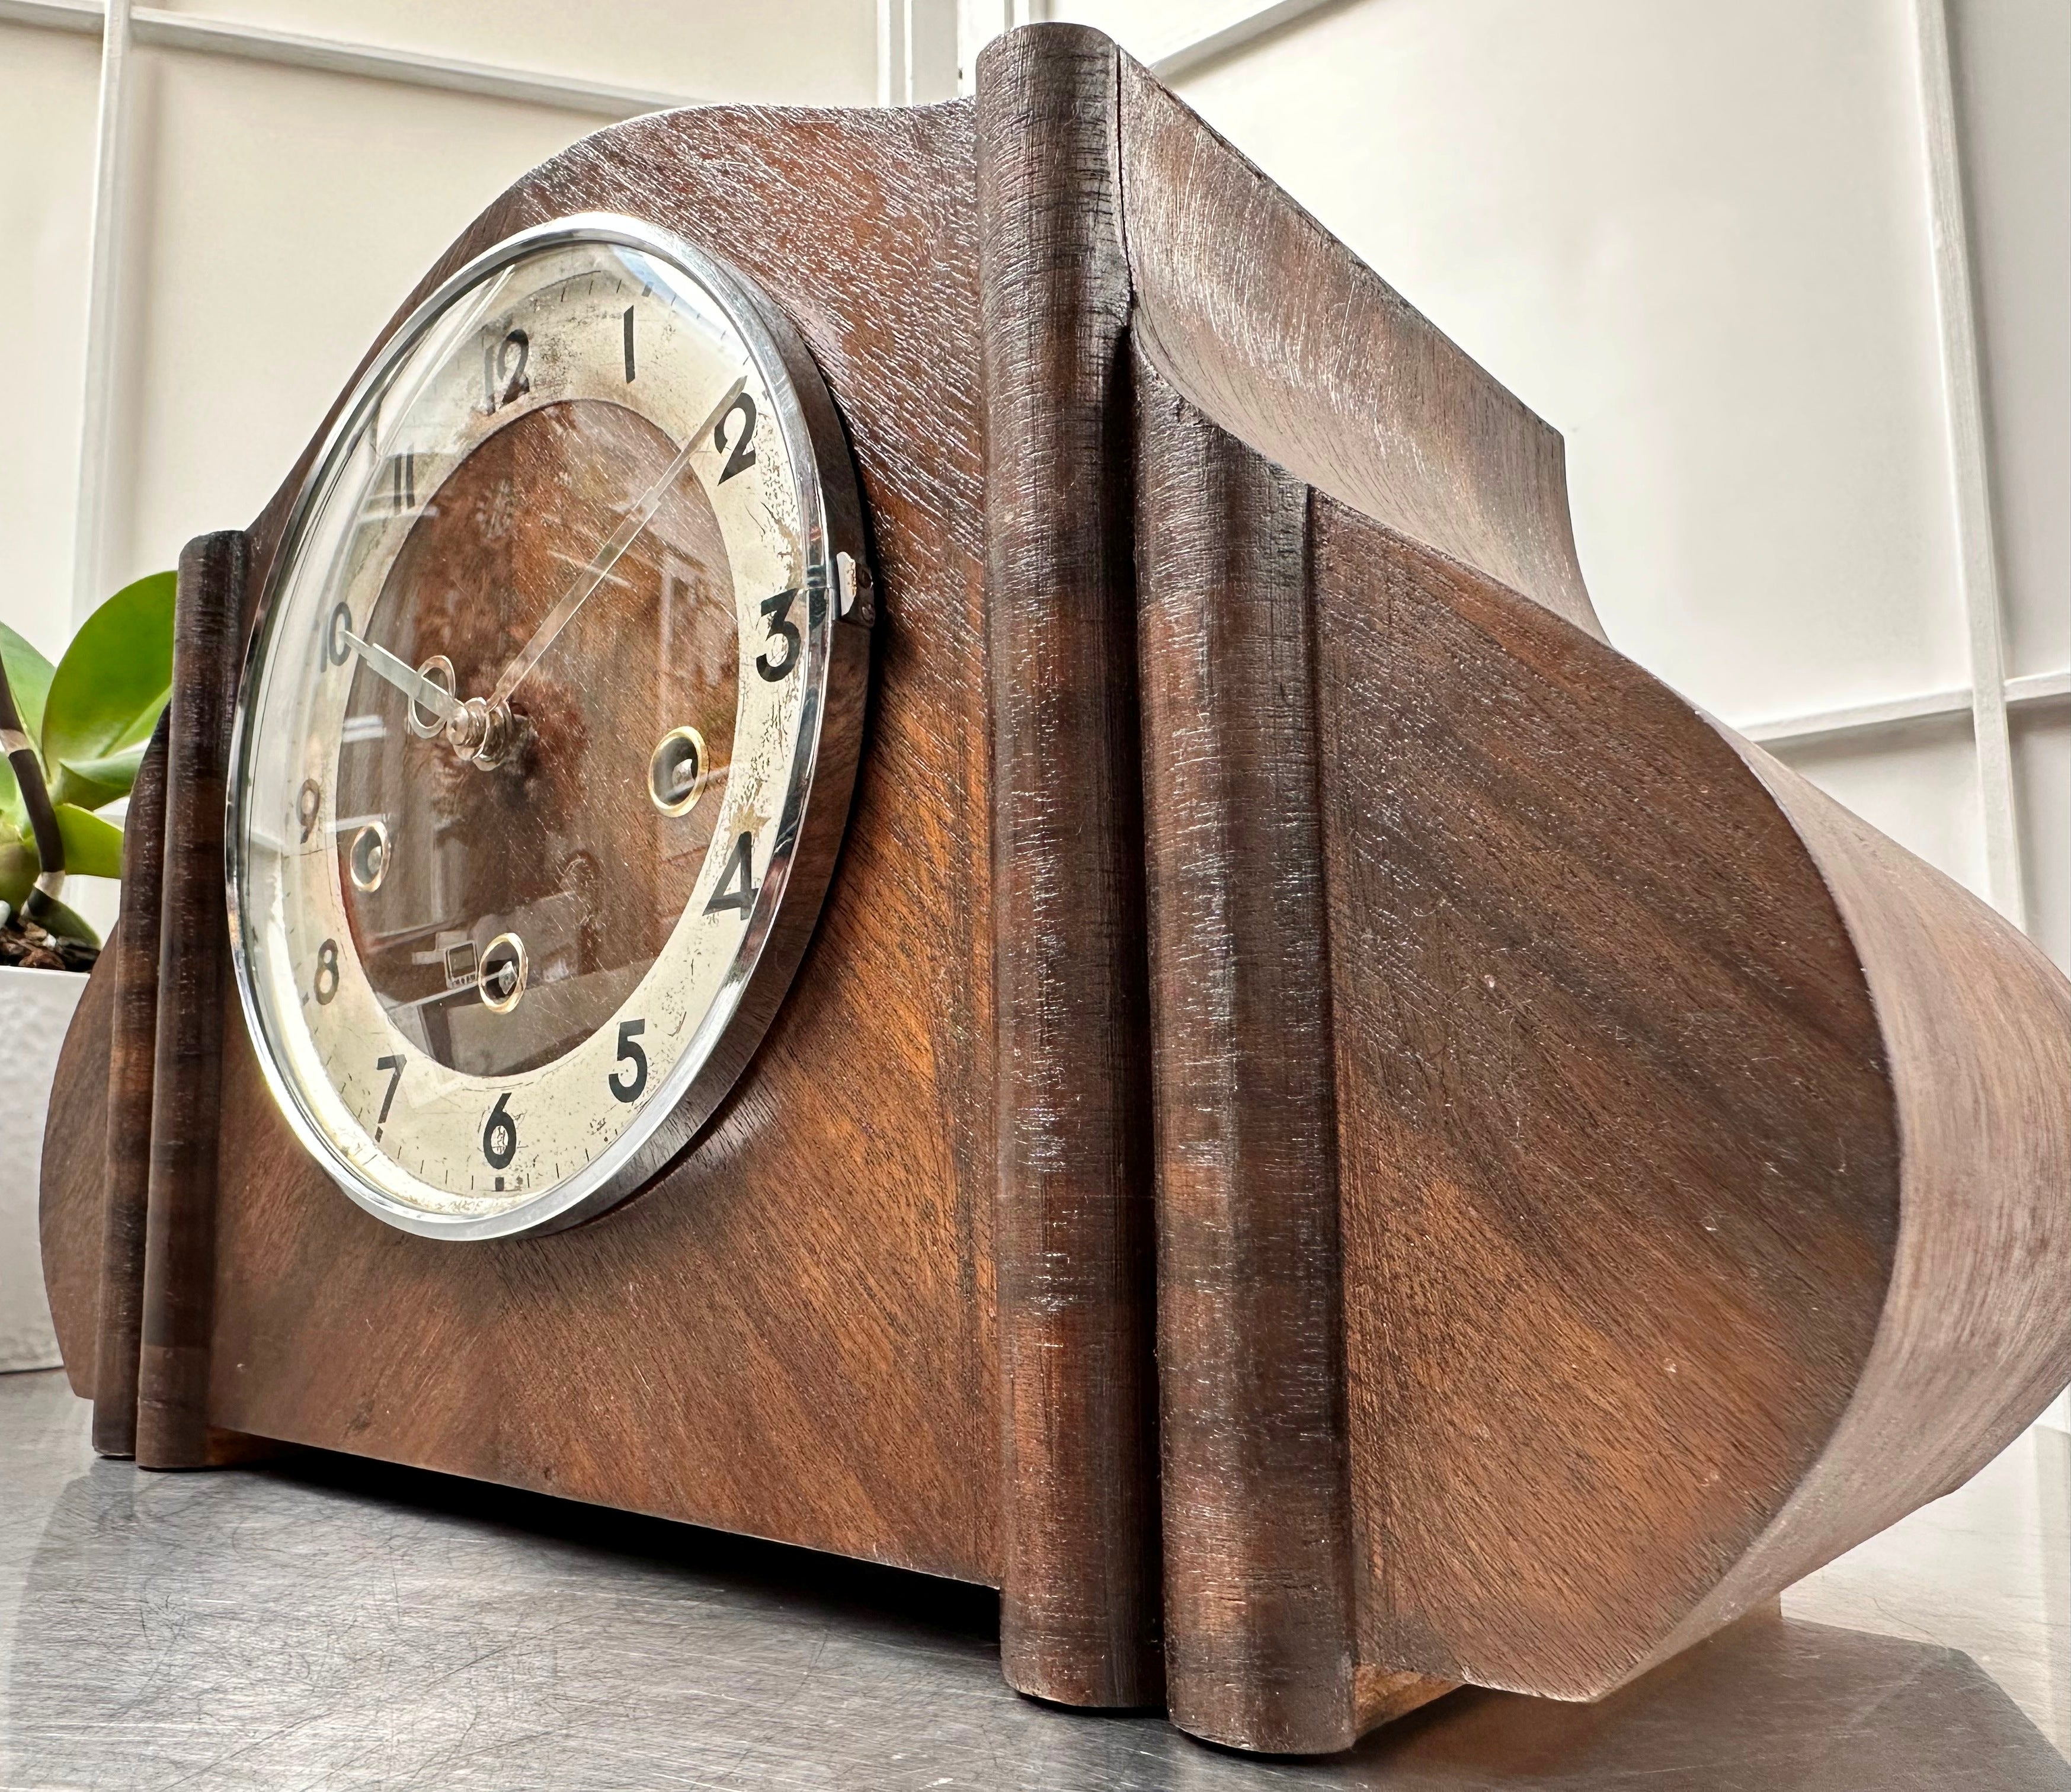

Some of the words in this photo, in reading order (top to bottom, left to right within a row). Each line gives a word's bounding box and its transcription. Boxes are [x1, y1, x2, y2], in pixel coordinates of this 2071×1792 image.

[484, 329, 530, 415] 12
[624, 305, 635, 383] 1
[714, 392, 757, 487] 2
[321, 601, 352, 673] 10
[756, 587, 802, 682] 3
[296, 778, 320, 844] 9
[702, 831, 760, 920] 4
[314, 938, 339, 1006] 8
[377, 1054, 406, 1124] 7
[609, 1019, 647, 1103] 5
[483, 1093, 516, 1169] 6
